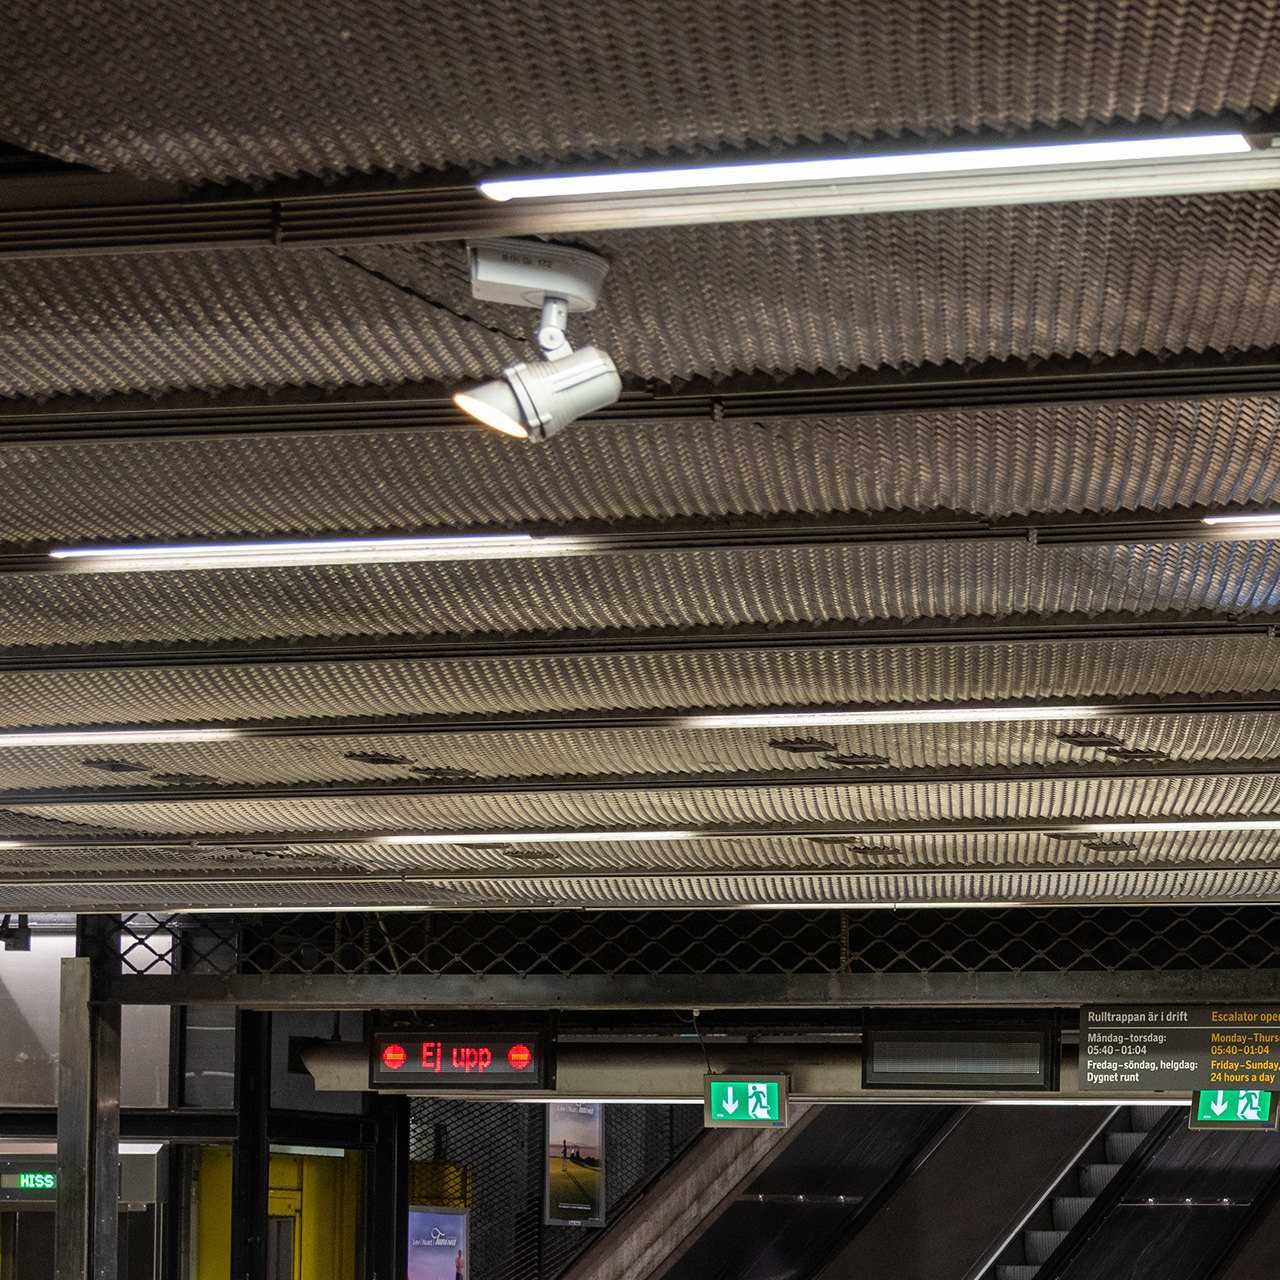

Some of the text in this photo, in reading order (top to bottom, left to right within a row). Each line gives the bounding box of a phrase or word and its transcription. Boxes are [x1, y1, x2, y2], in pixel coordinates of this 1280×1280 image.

[1088, 1011, 1188, 1024] Rulltrappan är i drift
[1211, 1011, 1258, 1022] Escalator
[421, 1042, 492, 1073] Ej upp
[1160, 1060, 1198, 1071] helgdag:
[1087, 1072, 1140, 1084] Dygnet runt
[1210, 1072, 1275, 1084] 24 hours a day
[19, 1173, 55, 1189] HISS
